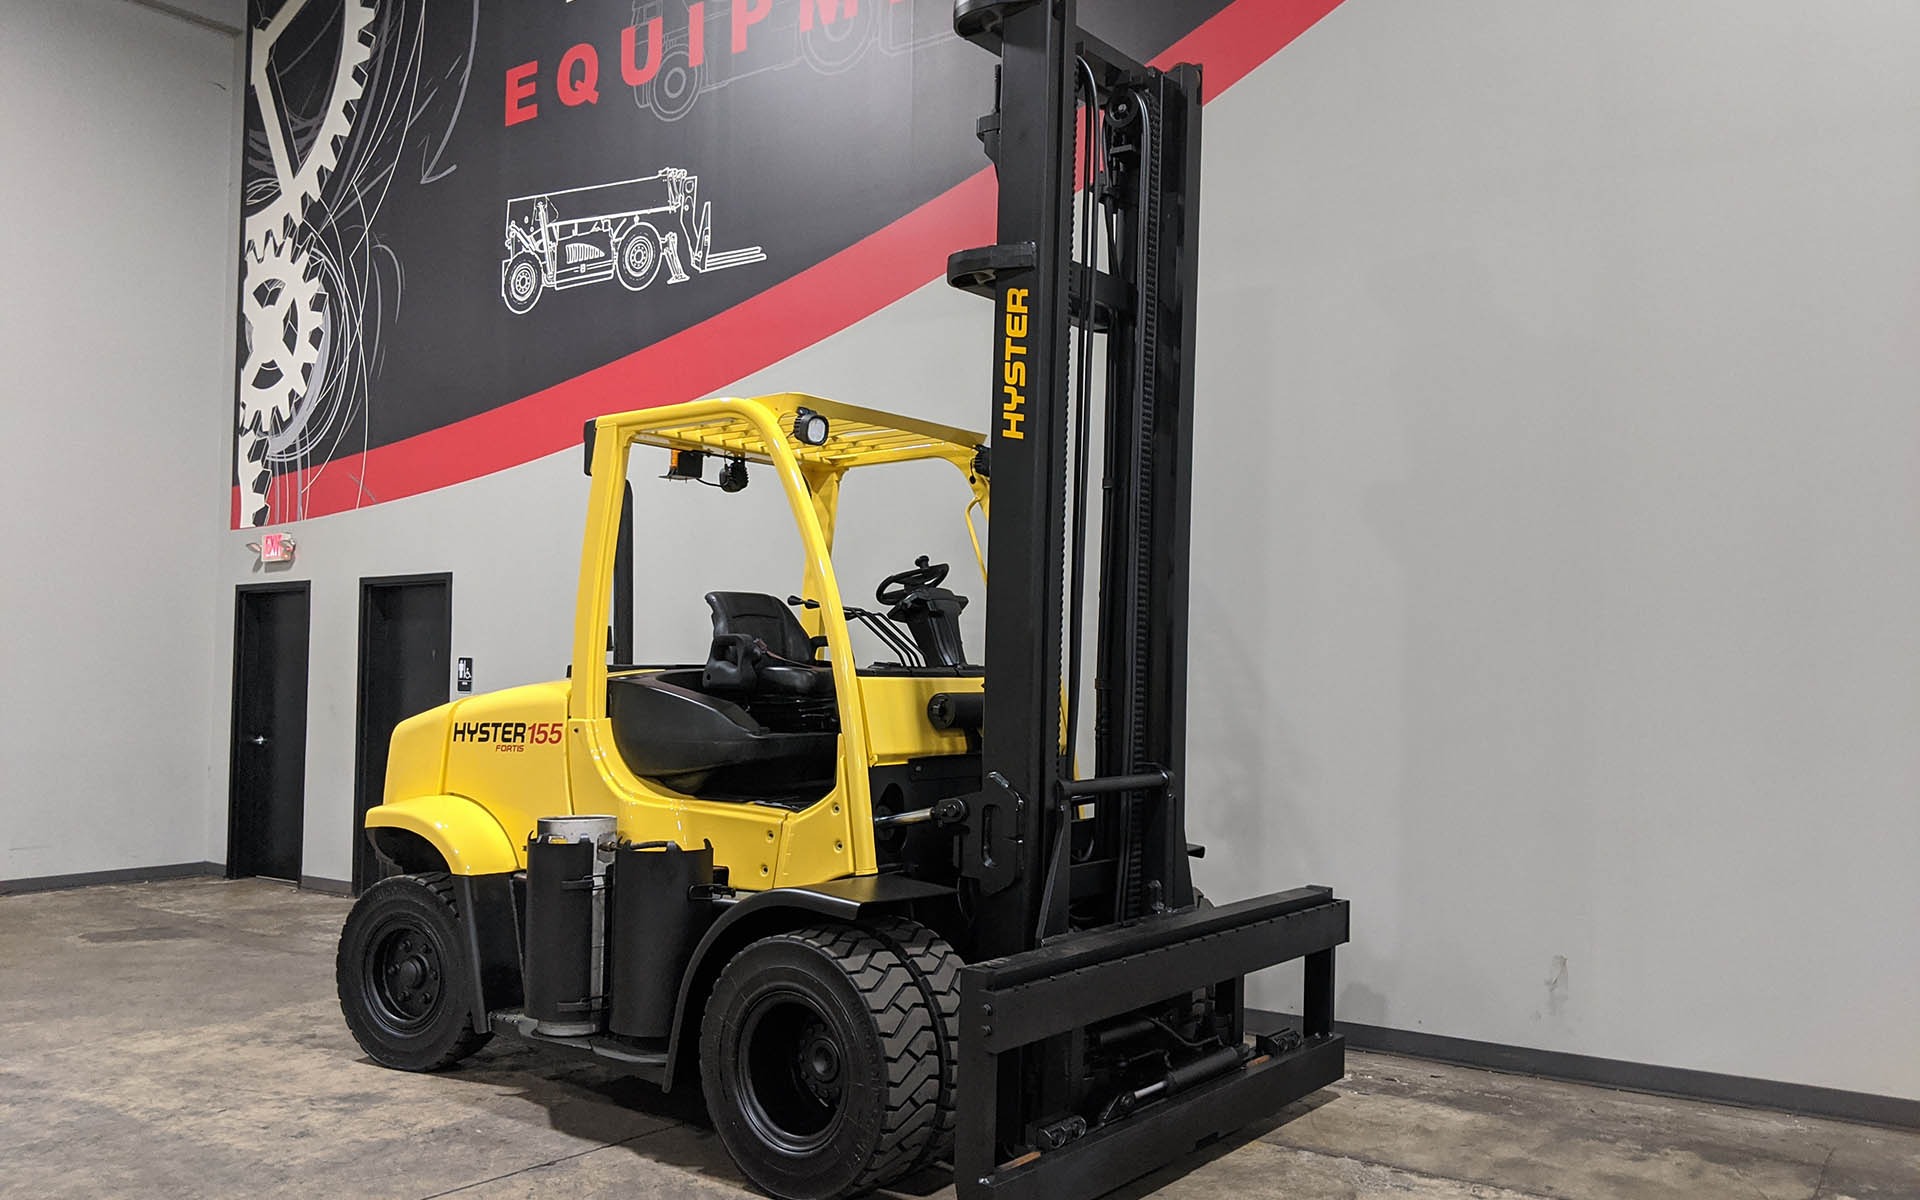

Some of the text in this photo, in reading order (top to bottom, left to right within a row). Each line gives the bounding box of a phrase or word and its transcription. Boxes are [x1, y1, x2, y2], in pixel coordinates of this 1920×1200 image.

[505, 0, 900, 127] EQUIP
[1002, 287, 1029, 440] HYSTER
[453, 722, 564, 744] HYSTER 155
[495, 744, 525, 753] FORTIS
